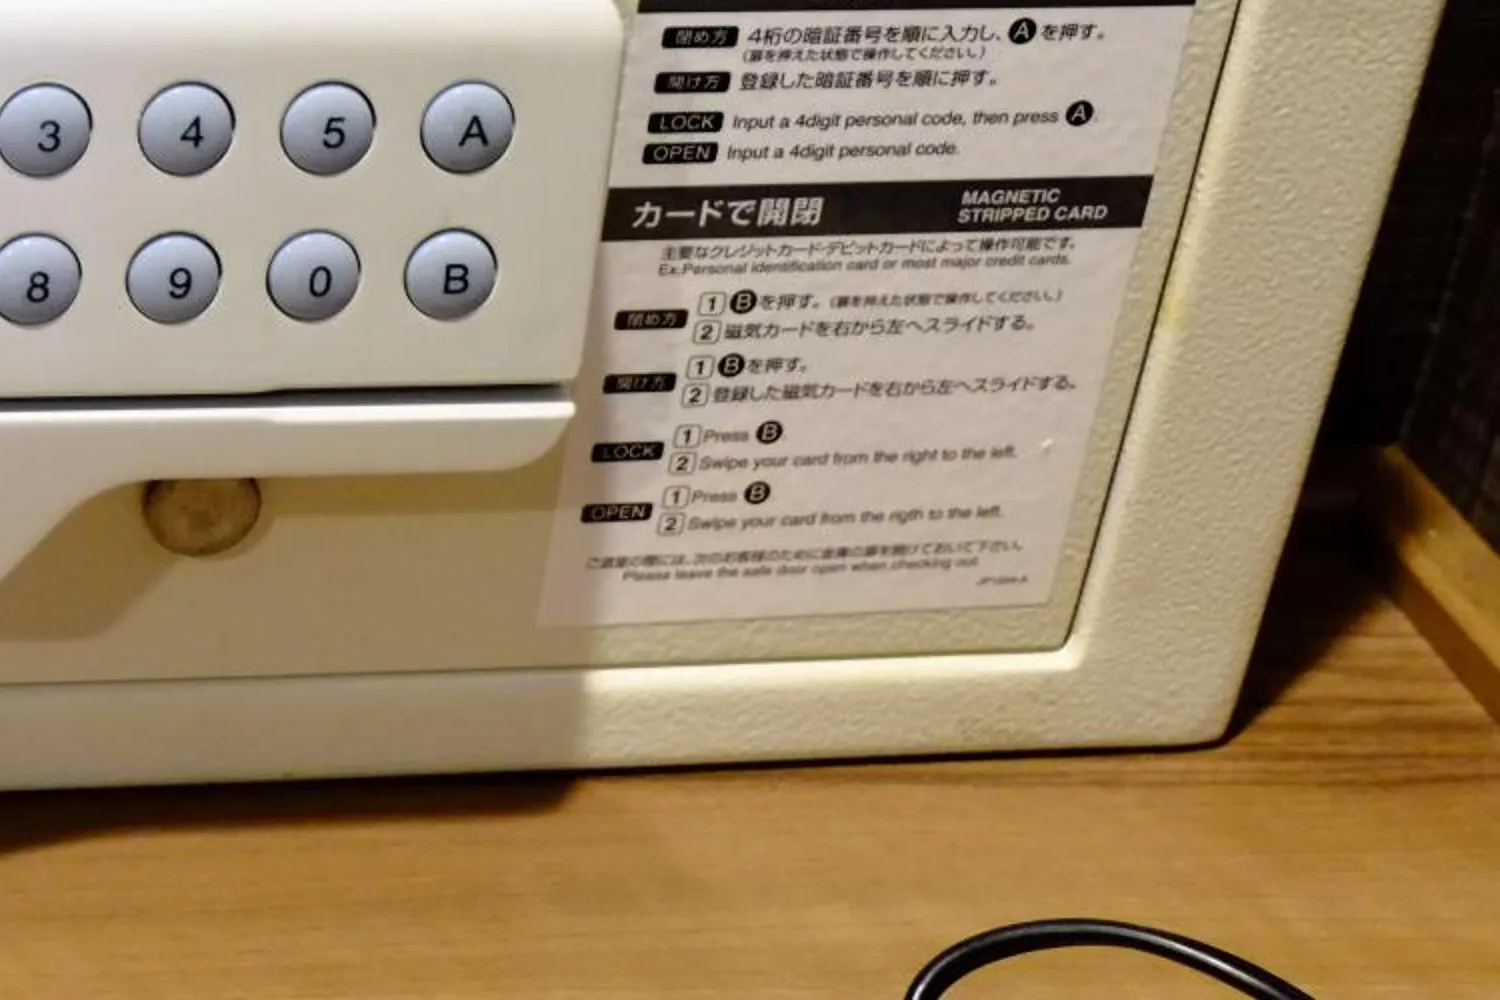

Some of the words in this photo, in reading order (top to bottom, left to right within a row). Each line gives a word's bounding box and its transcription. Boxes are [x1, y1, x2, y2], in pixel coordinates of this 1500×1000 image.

[657, 113, 718, 132] LOCK
[732, 114, 776, 131] Input
[779, 117, 790, 129] a
[794, 113, 842, 131] 4digit
[844, 112, 918, 130] personal
[921, 110, 967, 126] code,
[972, 109, 1009, 125] then
[1012, 113, 1059, 127] press
[37, 120, 62, 152] 3
[179, 116, 204, 148] 4
[322, 117, 346, 148] 5
[457, 115, 490, 148] A
[651, 144, 713, 163] OPEN
[727, 144, 770, 161] Input
[773, 148, 784, 159] a
[789, 143, 836, 161] 4digit
[838, 142, 912, 162] personal
[961, 188, 1061, 206] MAGNETIC
[631, 197, 825, 229] カードで開閉
[957, 206, 1052, 224] STRIPPED
[1055, 204, 1109, 222] CARD
[751, 260, 842, 274] identification
[845, 259, 880, 271] card
[882, 259, 898, 269] or
[901, 257, 937, 269] most
[940, 255, 982, 270] major
[985, 254, 1025, 267] credit
[26, 272, 50, 304] 8
[167, 267, 192, 299] 9
[308, 266, 332, 297] 0
[443, 264, 470, 294] B
[703, 428, 750, 443] Press
[601, 442, 657, 460] LOCK
[698, 456, 748, 472] Swipe
[752, 456, 788, 470] your
[792, 452, 830, 466] card
[832, 451, 869, 465] from
[873, 450, 899, 463] the
[902, 449, 939, 466] right
[941, 449, 958, 461] to
[961, 447, 987, 460] the
[691, 490, 738, 504] Press
[589, 504, 648, 522] OPEN
[687, 516, 736, 532] Swipe
[740, 516, 776, 530] your
[780, 512, 817, 527] card
[819, 511, 856, 525] from
[860, 510, 885, 523] the
[928, 509, 943, 521] to
[947, 507, 973, 519] the
